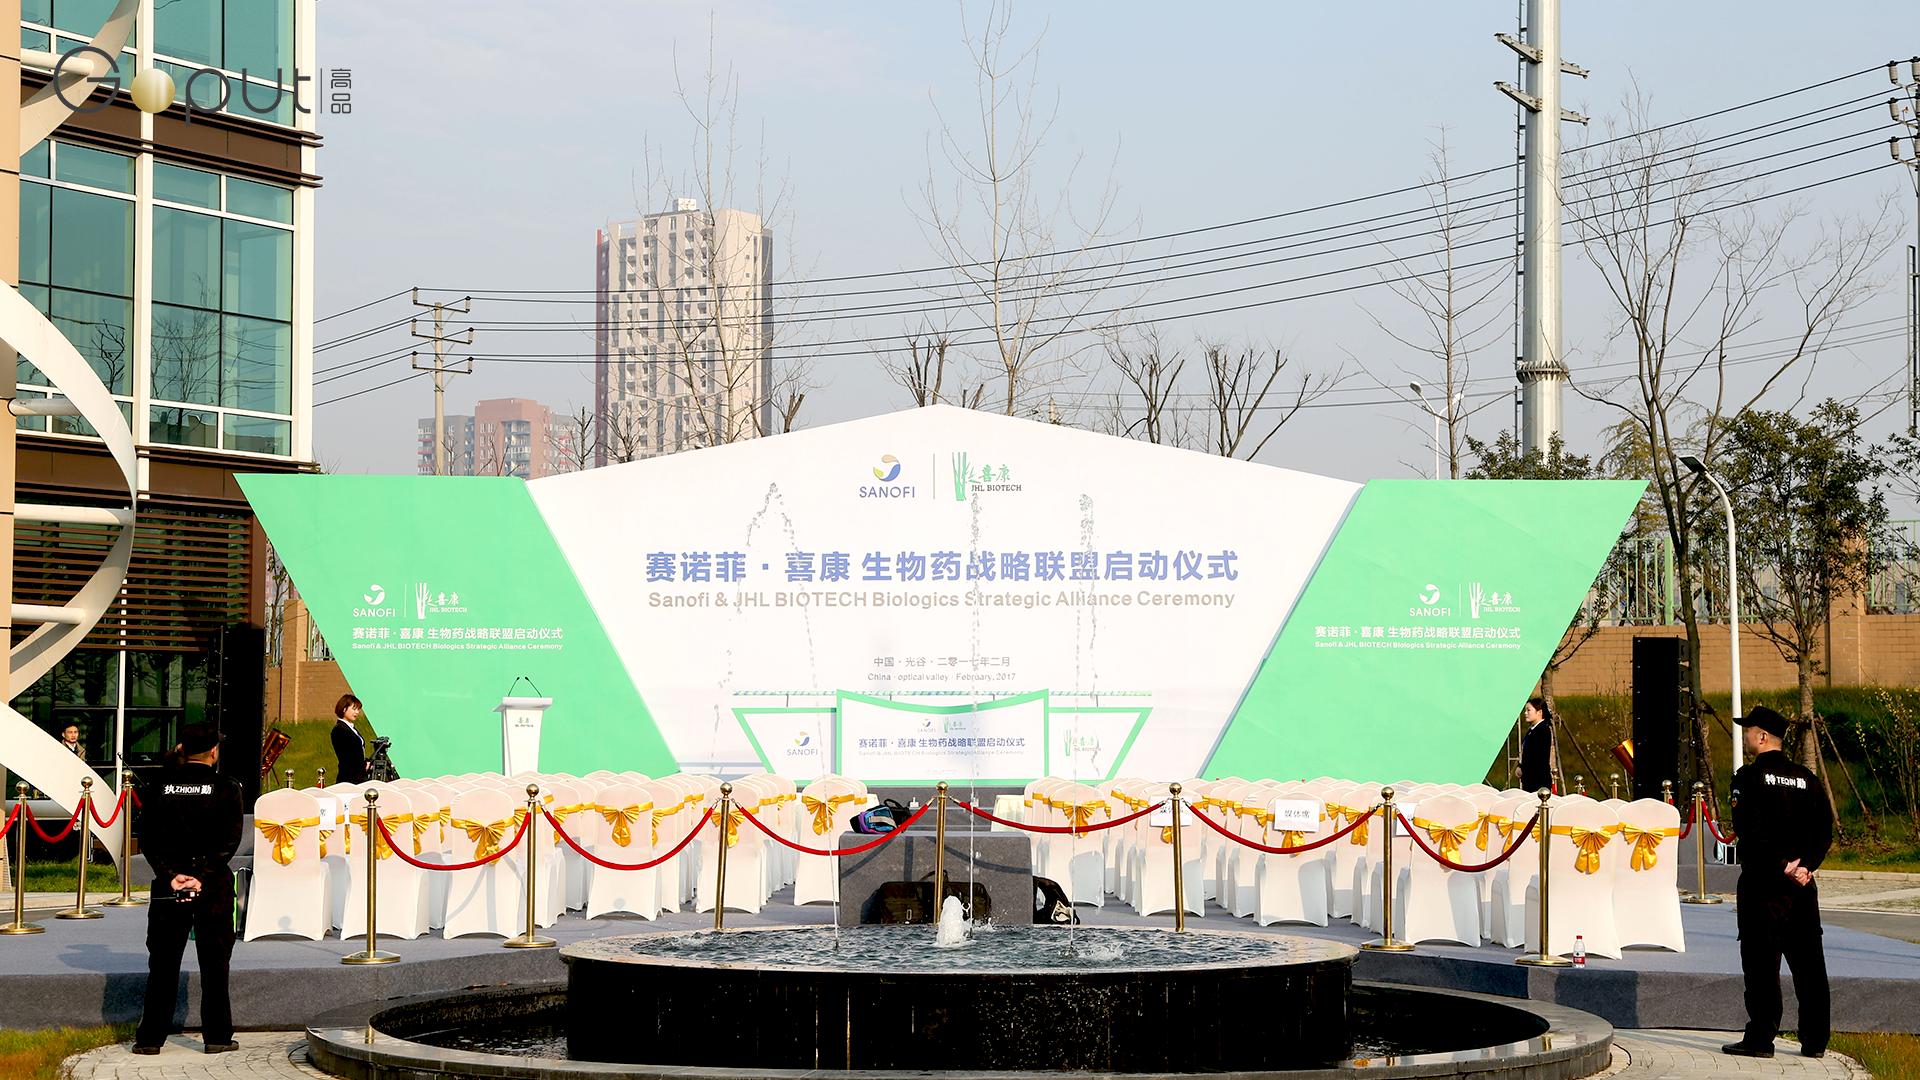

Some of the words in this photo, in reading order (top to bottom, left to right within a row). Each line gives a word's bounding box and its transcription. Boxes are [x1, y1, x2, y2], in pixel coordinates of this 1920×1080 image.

[859, 486, 916, 498] SANOFI
[971, 484, 985, 492] JHL
[987, 484, 1022, 492] BIOTECH
[862, 550, 1239, 583] 生物药战略联盟启动仪式
[648, 592, 710, 608] Sanofi
[715, 592, 729, 608] &
[733, 592, 770, 608] JHL
[775, 592, 867, 607] BIOTECH
[872, 591, 960, 610] Biologics
[964, 591, 1052, 610] Strategic
[1055, 591, 1133, 607] Alliance
[1137, 590, 1236, 609] Ceremony
[352, 608, 396, 618] SANOFI
[1409, 607, 1451, 617] SANOFI
[1358, 641, 1392, 649] BIOTECH
[867, 672, 892, 681] China
[897, 672, 925, 683] optical
[926, 672, 949, 683] valley
[996, 672, 1016, 681] 2017
[786, 748, 819, 756] SANOFI
